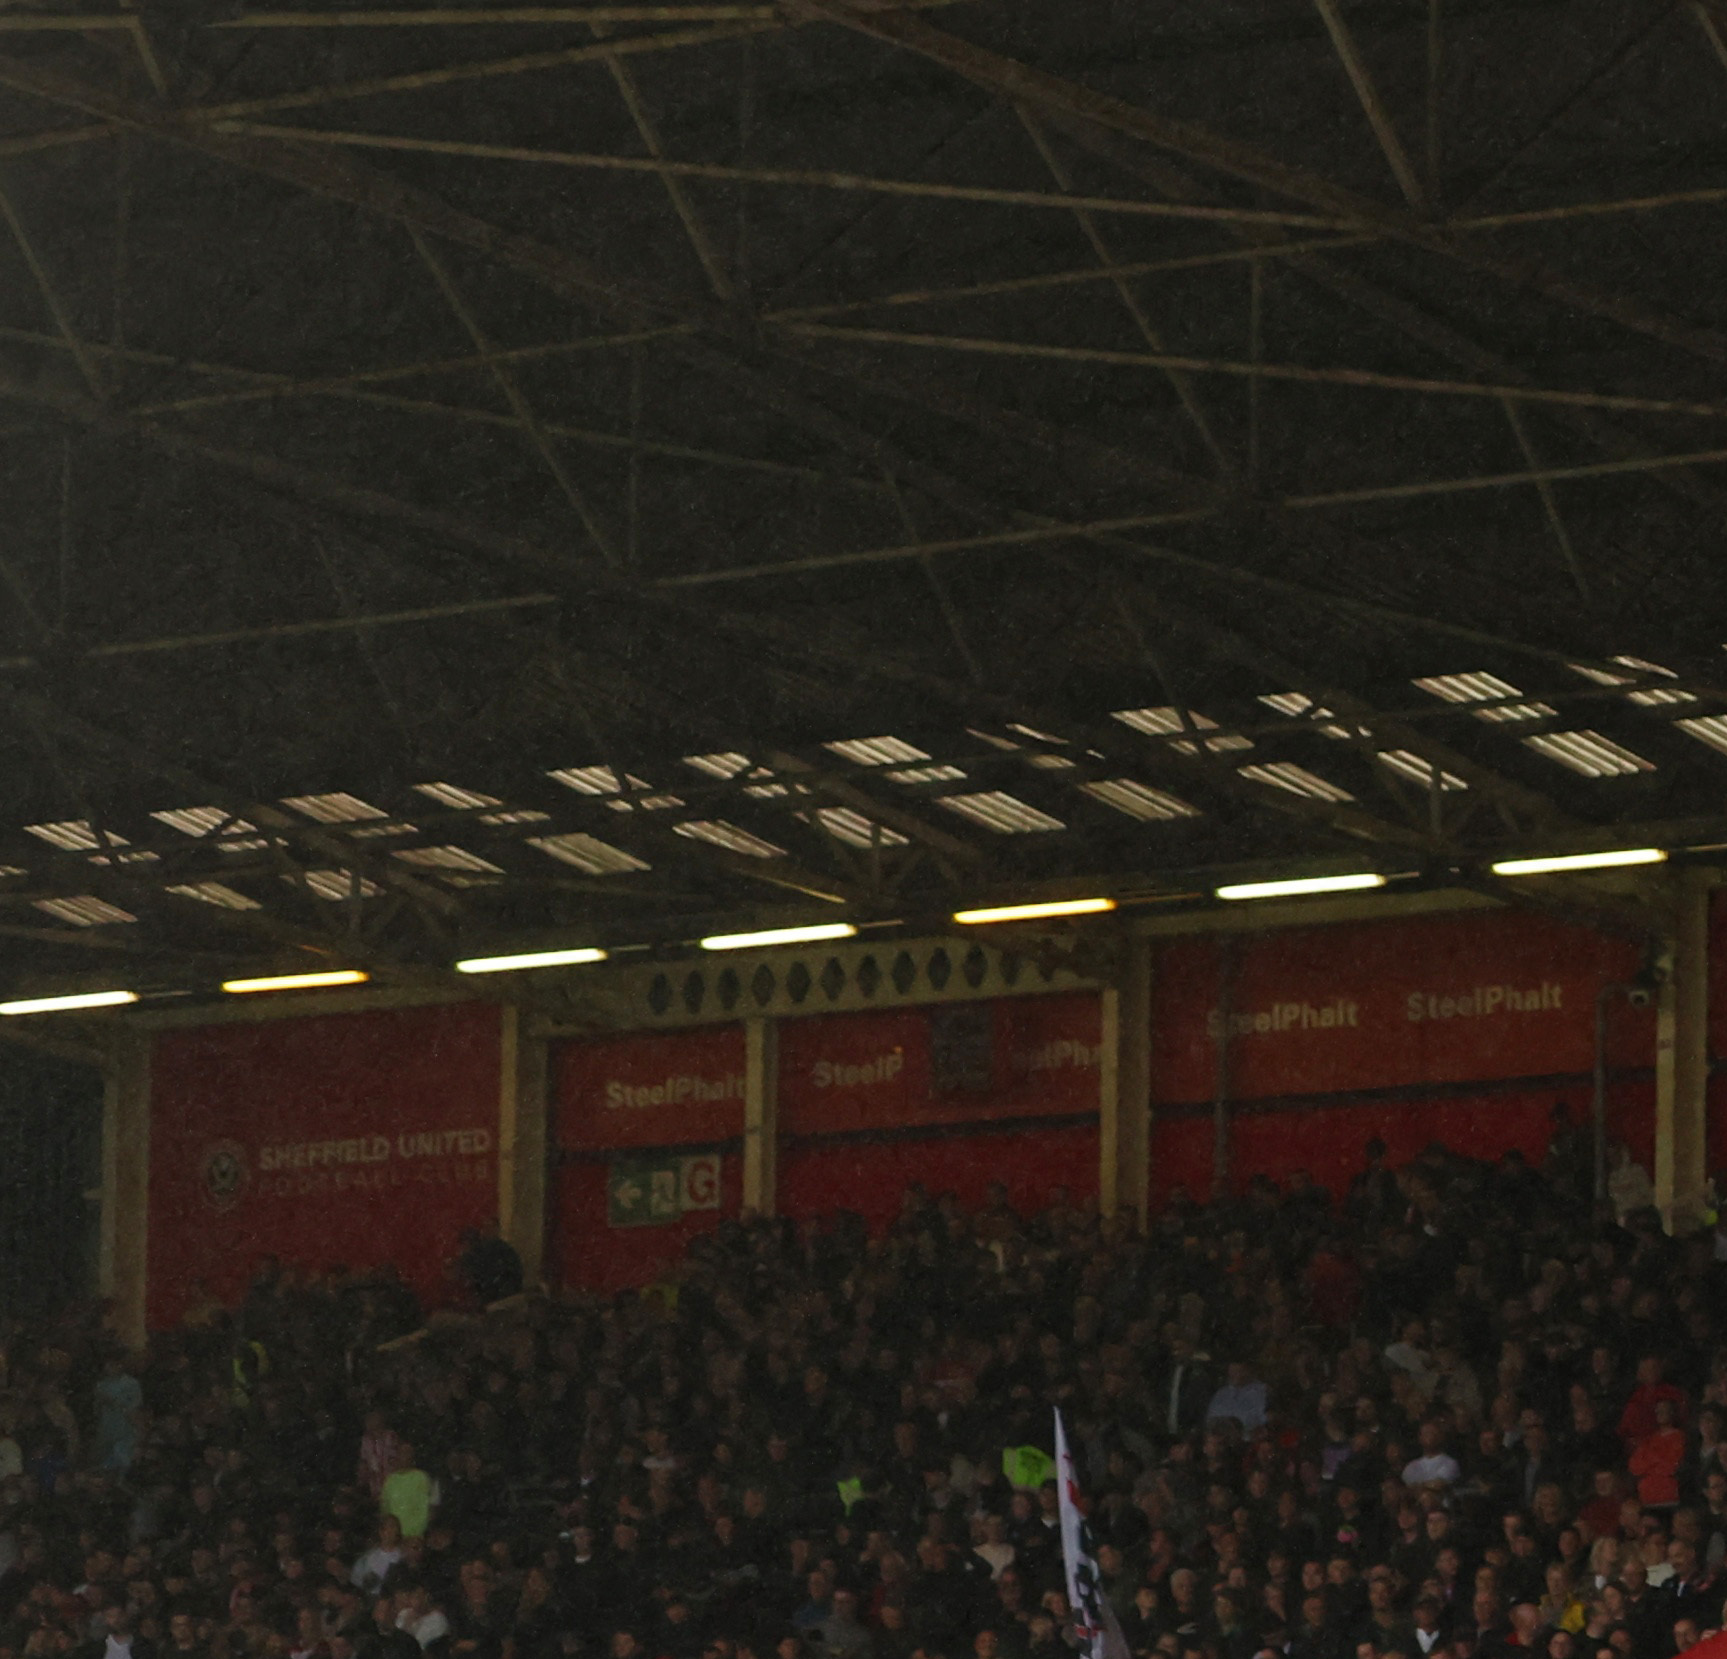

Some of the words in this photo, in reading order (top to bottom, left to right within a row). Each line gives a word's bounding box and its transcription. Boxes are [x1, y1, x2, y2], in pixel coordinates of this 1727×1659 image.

[1407, 982, 1562, 1022] SteelPhalt
[259, 1136, 390, 1170] SHEFFIELD
[398, 1129, 490, 1158] UNITED
[687, 1161, 715, 1203] G
